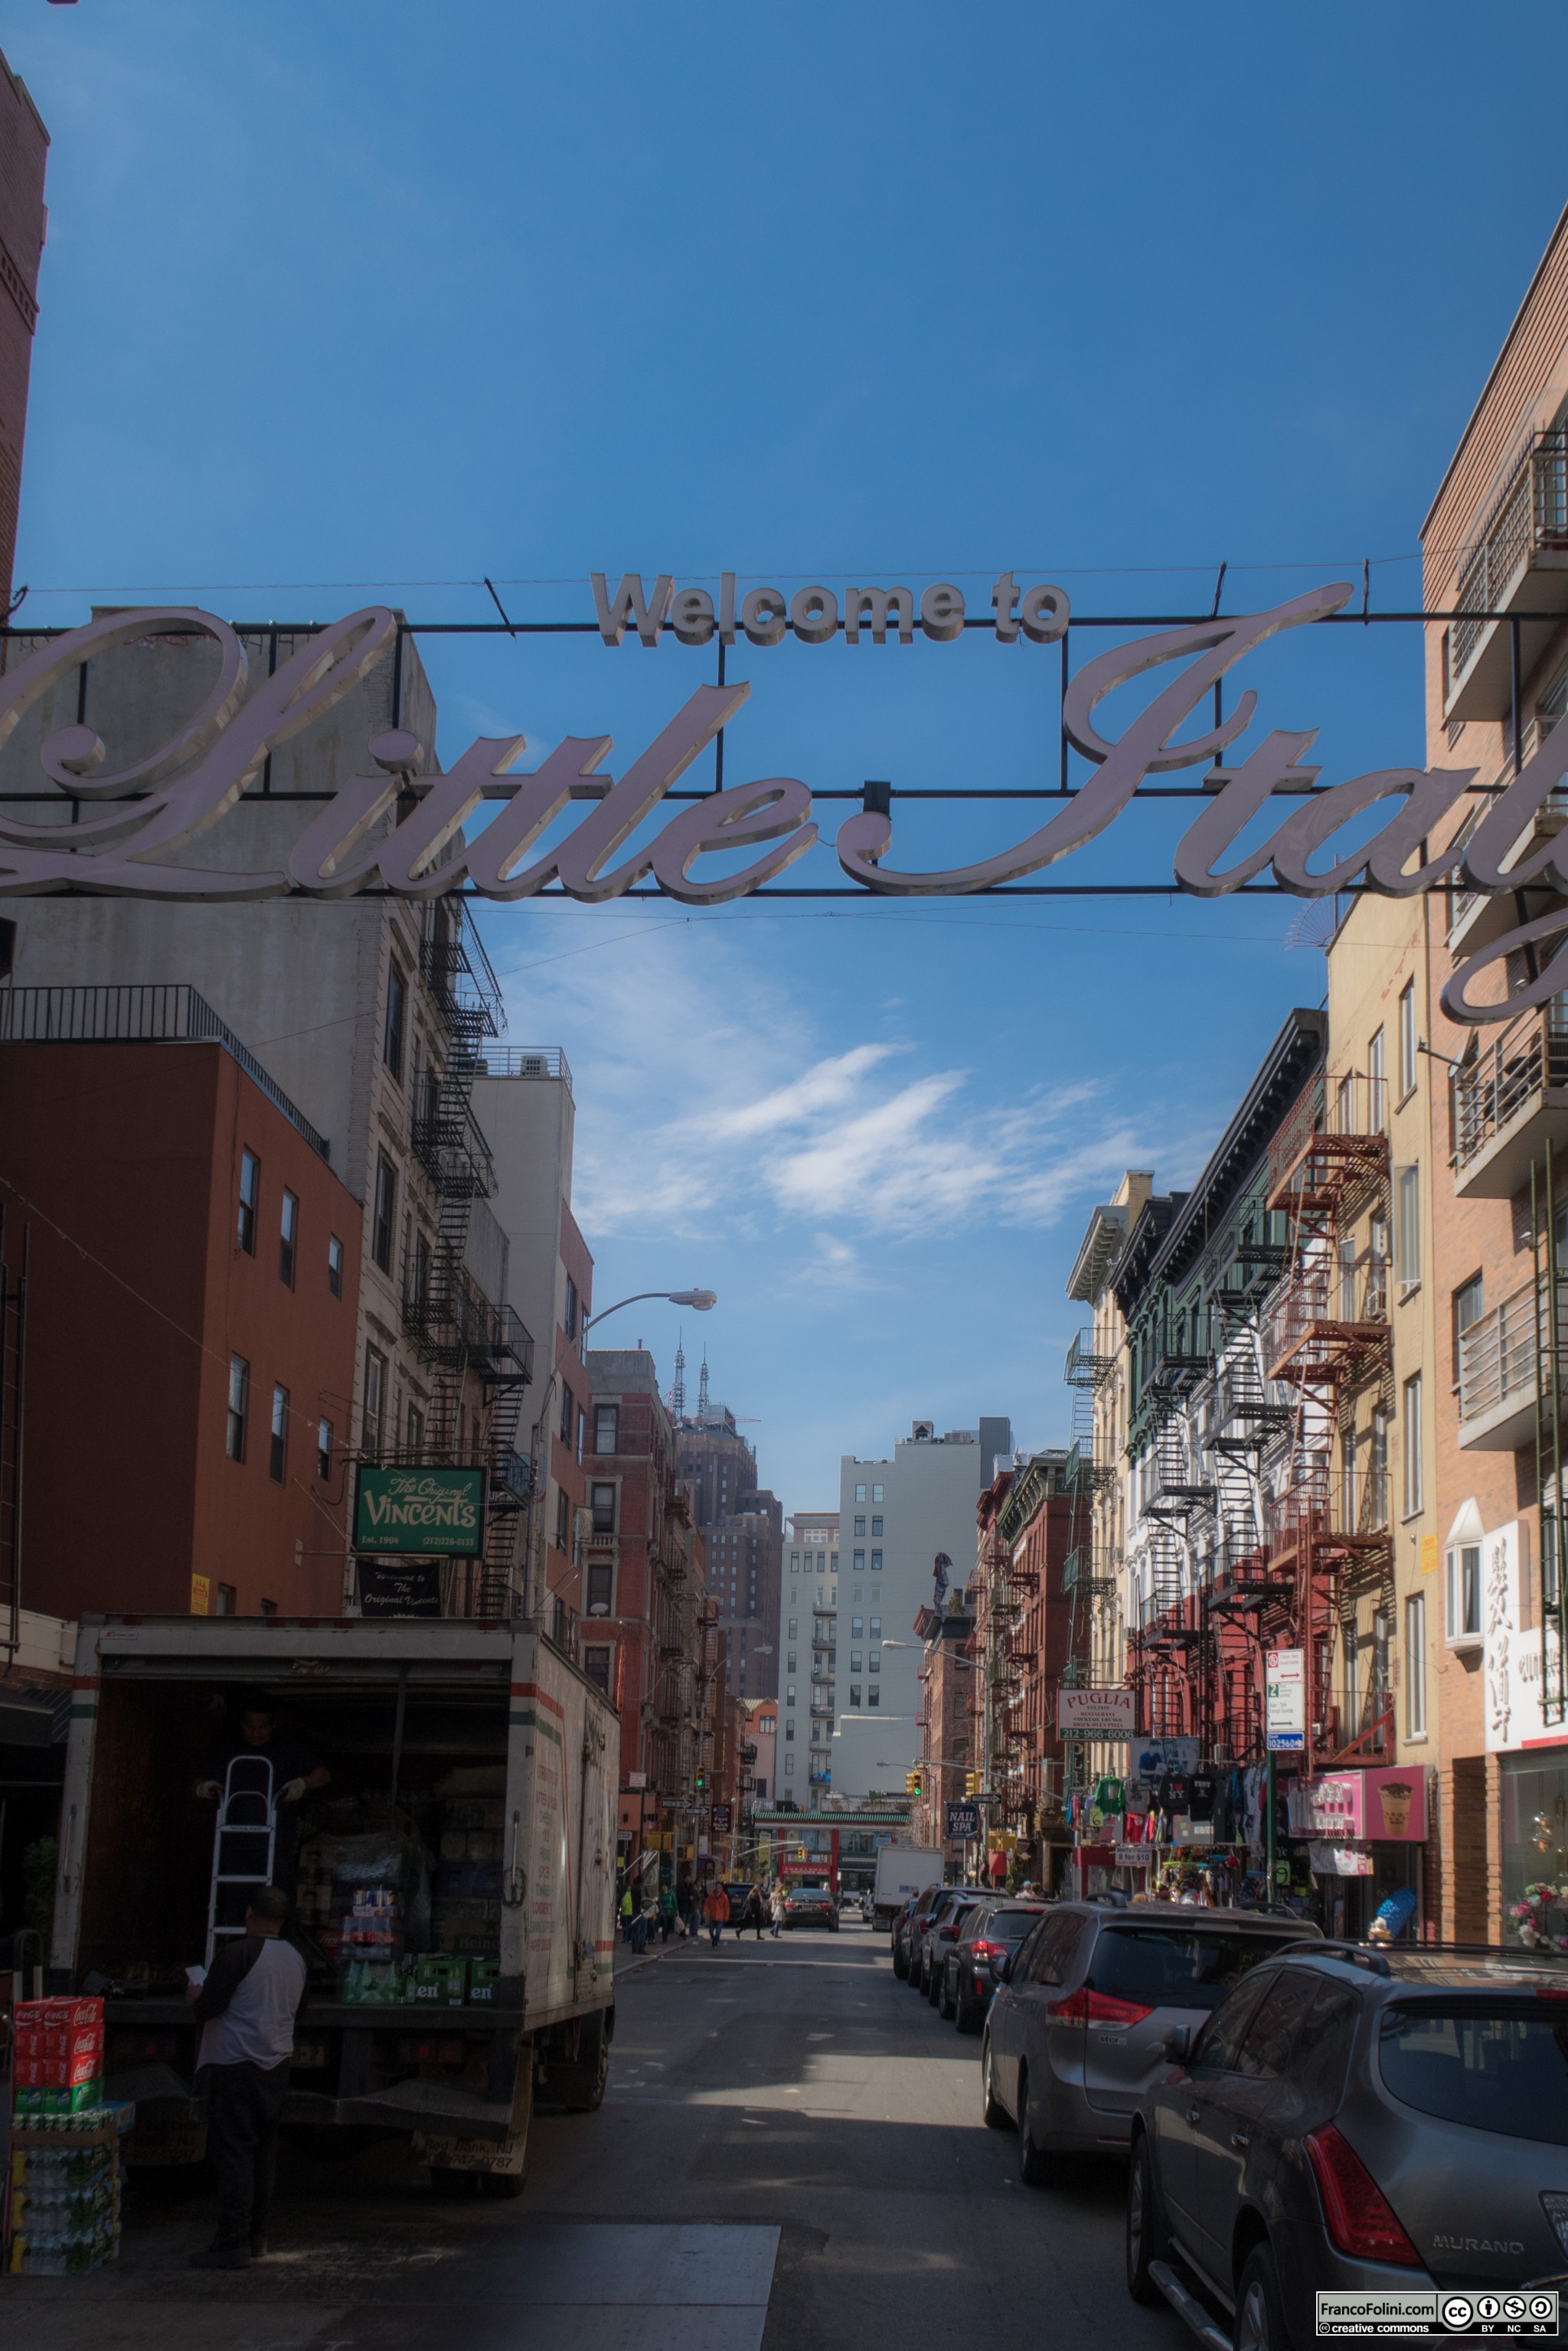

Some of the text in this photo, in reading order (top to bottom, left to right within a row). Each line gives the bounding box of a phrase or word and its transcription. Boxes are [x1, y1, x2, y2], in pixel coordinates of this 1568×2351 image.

[590, 570, 1070, 648] Welcome to
[0, 605, 818, 906] Little
[388, 1478, 472, 1504] The Original
[364, 1490, 476, 1528] Vincent's
[361, 1536, 377, 1544] Est.
[379, 1536, 399, 1545] 1904
[375, 1572, 414, 1582] Welcome
[394, 1582, 411, 1593] The
[364, 1594, 403, 1605] Original
[1067, 1693, 1130, 1709] PUGLIA
[1062, 1729, 1134, 1739] 212-966-6006
[1168, 1791, 1184, 1799] NY
[949, 1811, 975, 1821] NAIL
[1093, 1814, 1101, 1825] 6
[952, 1822, 972, 1831] SPA
[496, 2143, 514, 2154] NJ
[1432, 2235, 1525, 2255] MURANO
